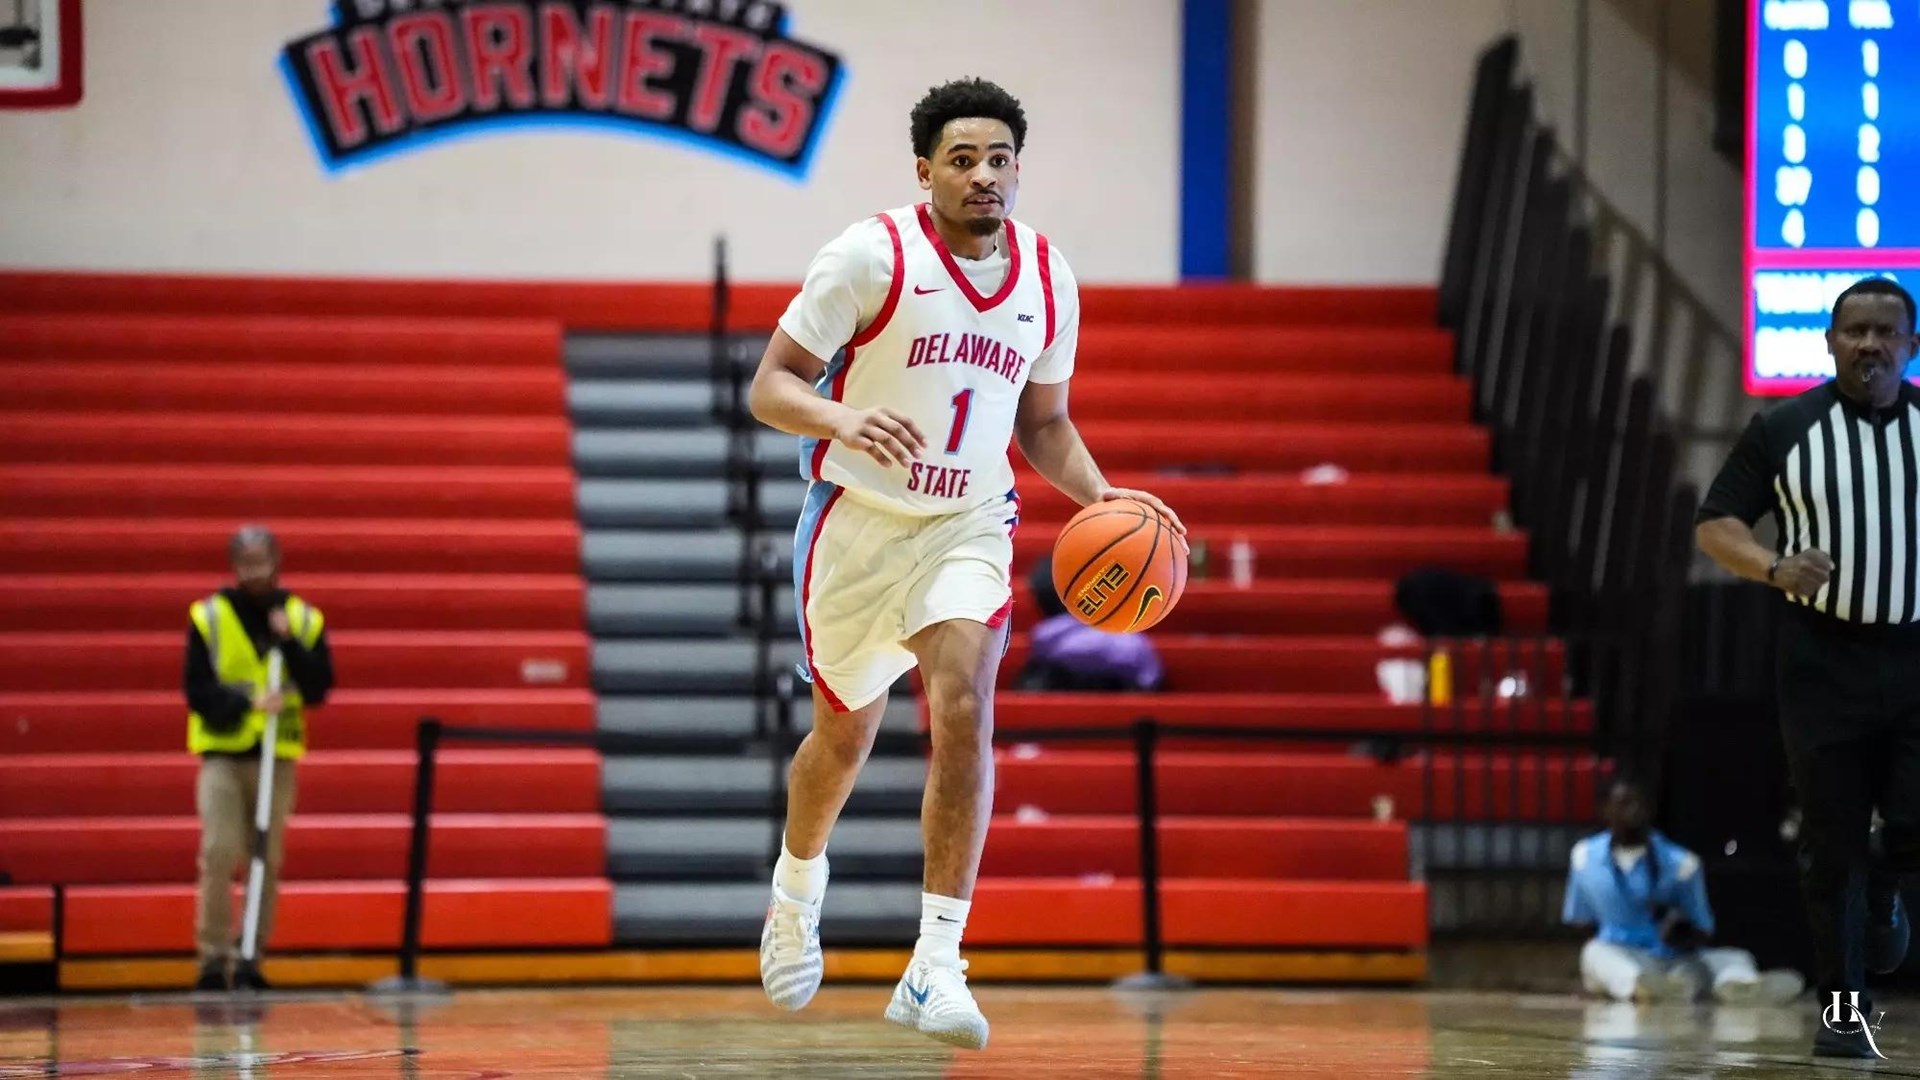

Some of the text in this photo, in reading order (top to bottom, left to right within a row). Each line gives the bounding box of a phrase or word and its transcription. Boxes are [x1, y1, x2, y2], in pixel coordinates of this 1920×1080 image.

[306, 3, 829, 156] HORNETS
[906, 332, 1025, 384] DELAWARE
[944, 387, 975, 456] 1
[907, 461, 971, 498] STATE
[1076, 562, 1130, 617] ELITE
